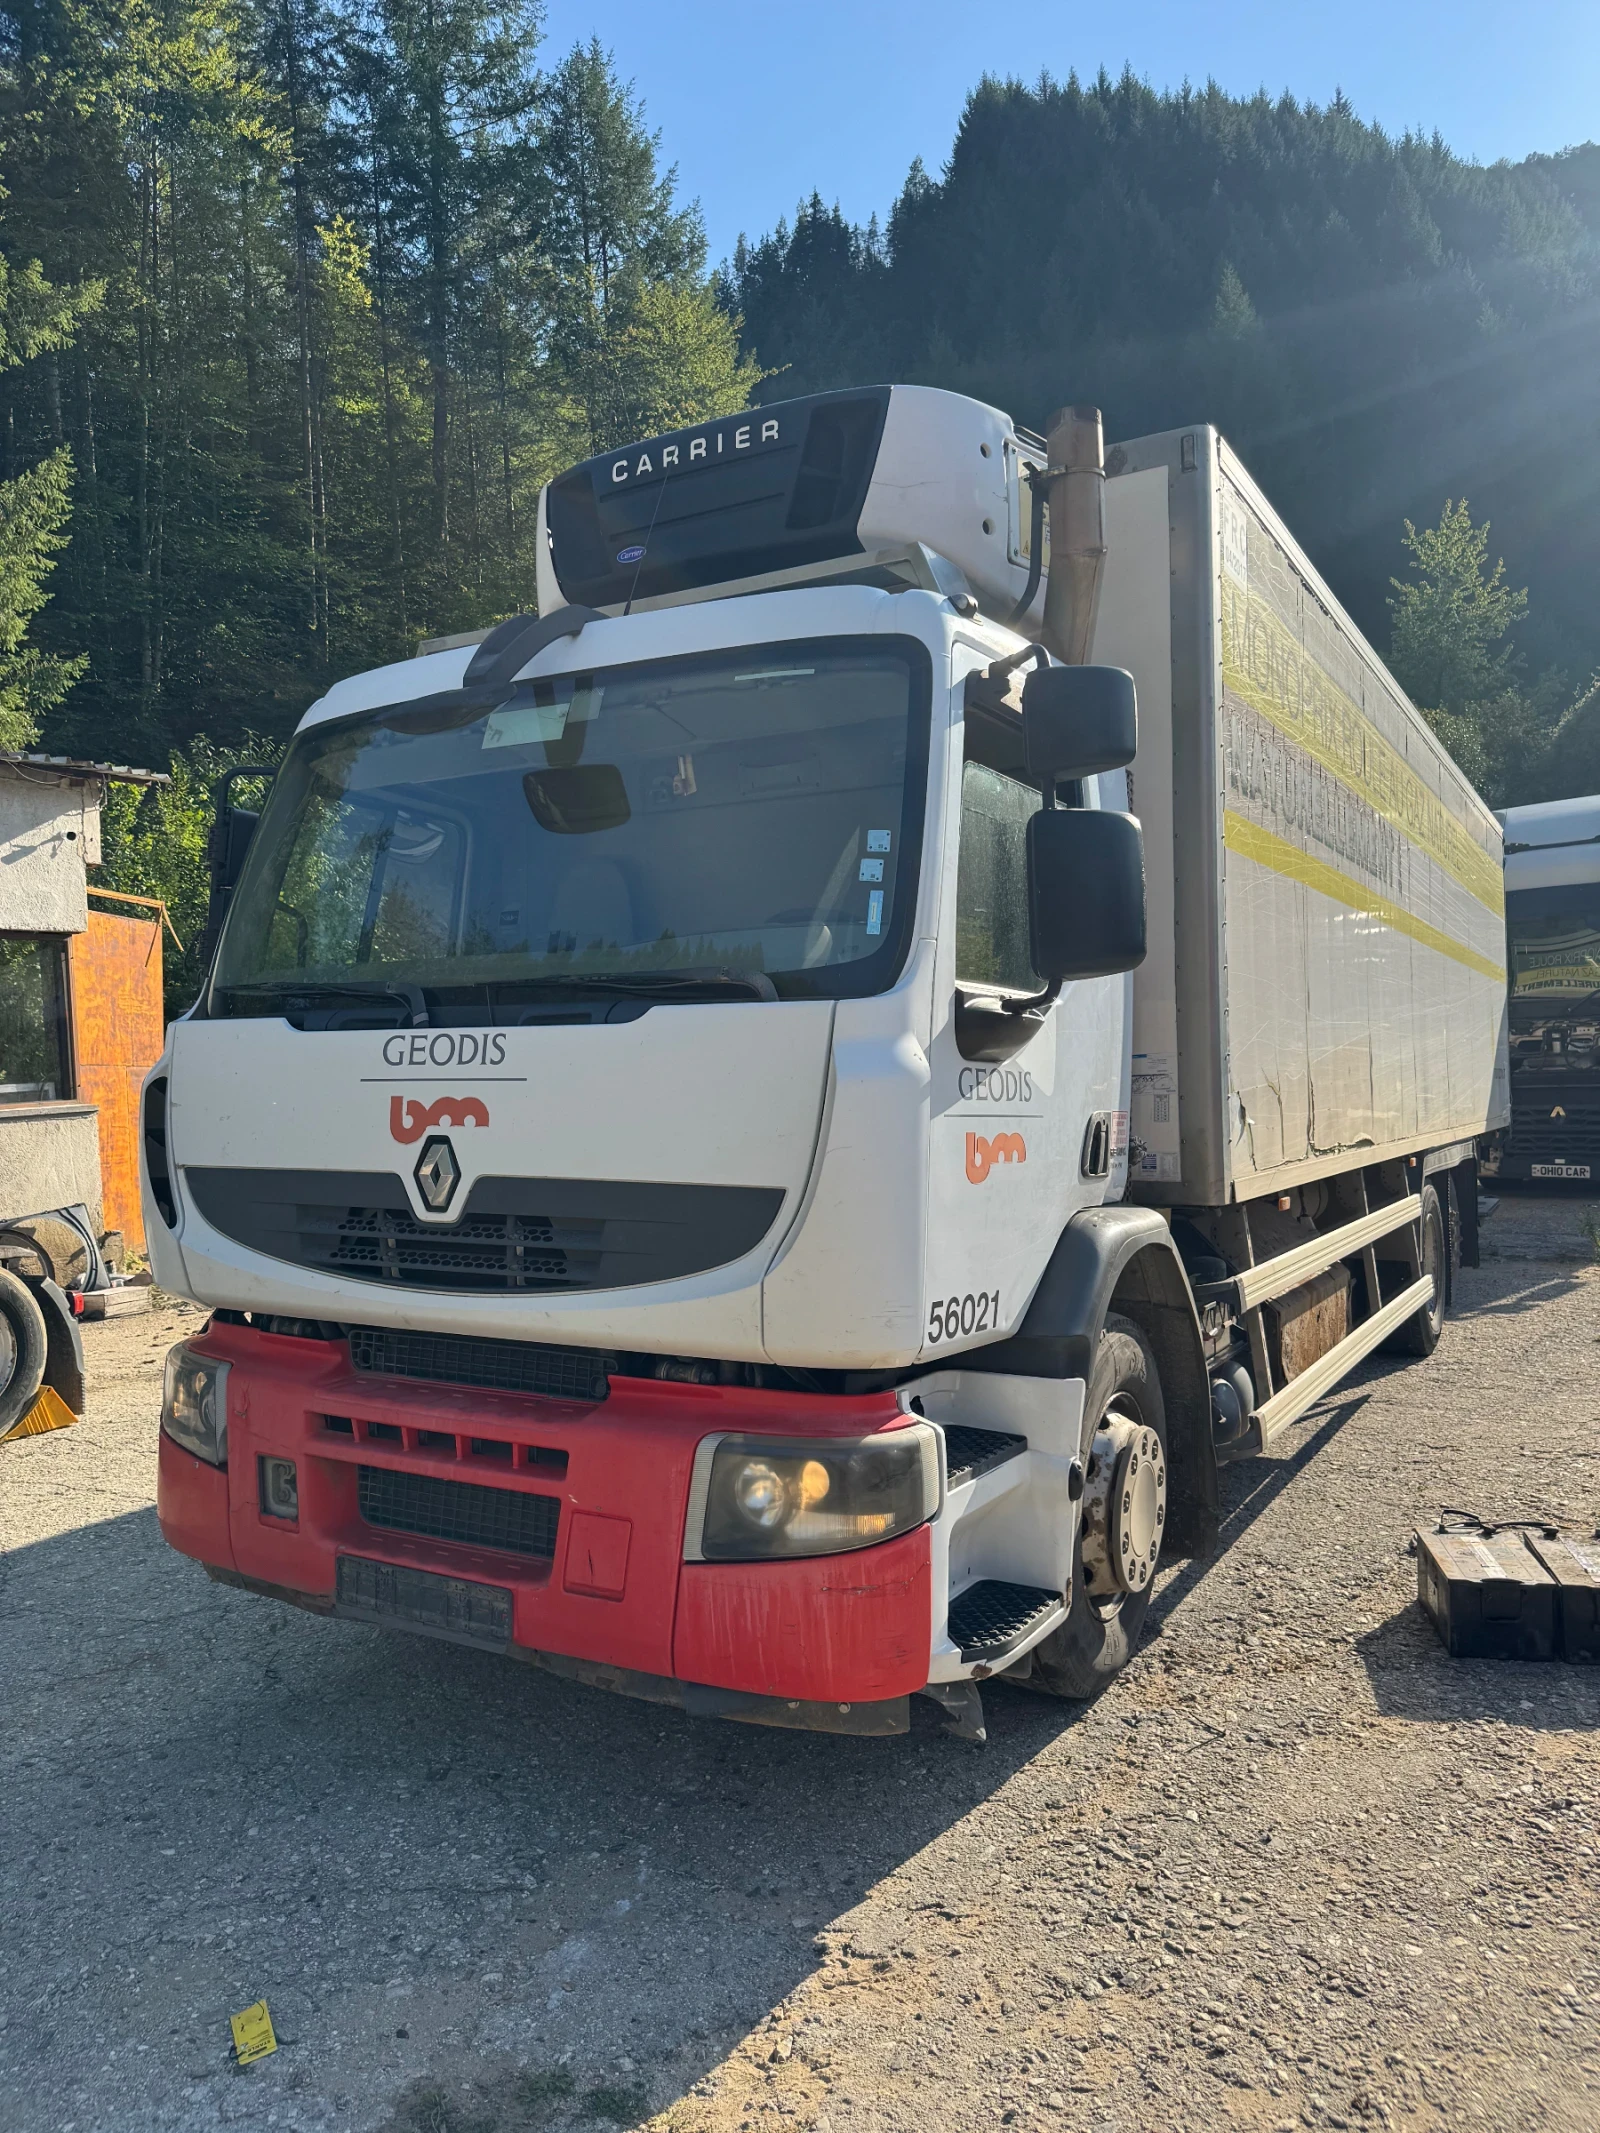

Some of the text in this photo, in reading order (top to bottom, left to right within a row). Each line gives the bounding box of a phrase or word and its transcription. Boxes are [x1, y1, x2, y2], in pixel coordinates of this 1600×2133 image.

[612, 419, 779, 483] CARRIER
[620, 549, 643, 560] Carrier
[1224, 503, 1246, 556] FRC
[1231, 588, 1338, 758] MONOPRIX
[1342, 705, 1384, 801] ROULE
[1406, 776, 1426, 838] GAZ
[1229, 706, 1395, 888] NATURELLEMENT
[382, 1032, 507, 1066] GEODIS
[958, 1066, 1032, 1102] GEODIS
[389, 1095, 490, 1145] bm
[965, 1131, 1027, 1185] bm
[1540, 1166, 1563, 1176] OHIO
[1565, 1167, 1586, 1177] CAR
[927, 1289, 1000, 1344] 56021
[245, 2040, 271, 2053] STANLE
